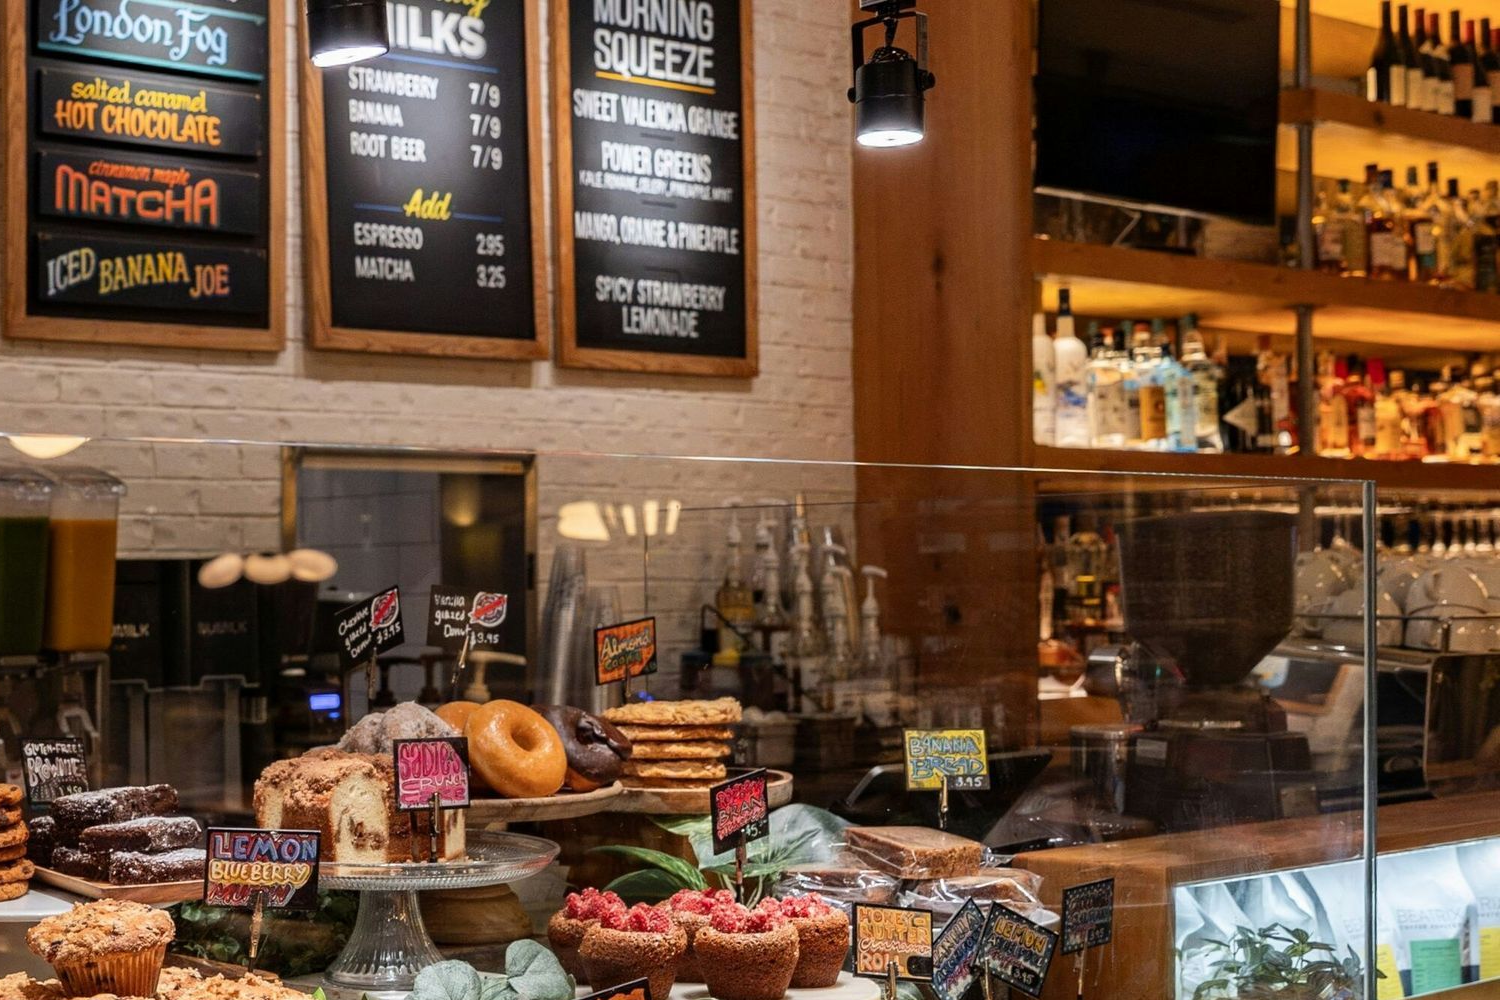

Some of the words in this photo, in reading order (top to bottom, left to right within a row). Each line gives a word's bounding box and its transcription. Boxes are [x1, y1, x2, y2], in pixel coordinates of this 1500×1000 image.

[49, 0, 172, 45] London
[168, 8, 229, 65] Fog
[386, 2, 488, 60] ILKS
[593, 0, 714, 41] MORNING
[593, 28, 715, 86] SQUEEZE
[71, 78, 131, 101] salted
[134, 88, 208, 113] caramel
[348, 66, 440, 100] STRAWBERRY
[55, 99, 98, 130] HOT
[101, 105, 222, 147] CHOCOLATE
[348, 98, 404, 127] BANANA
[573, 88, 619, 122] SWEET
[621, 95, 688, 133] VALENCIA
[687, 106, 739, 140] ORANGE
[350, 131, 388, 158] ROOT
[390, 136, 427, 163] BEER
[601, 141, 653, 175] POWER
[654, 148, 712, 183] GREENS
[55, 164, 219, 226] MATCHA
[403, 188, 453, 221] Add
[353, 222, 424, 250] ESPRESSO
[574, 211, 621, 245] MANGO,
[620, 215, 668, 248] ORANGE
[668, 221, 679, 248] &
[678, 222, 740, 255] PINEAPPLE
[47, 248, 96, 296] ICED
[98, 252, 191, 295] BANANA
[189, 264, 230, 298] JOE
[354, 256, 416, 282] MATCHA
[595, 275, 635, 303] SPICY
[636, 279, 726, 311] STRAWBERRY
[621, 305, 700, 338] LEMONADE
[909, 735, 982, 758] BANANA
[26, 756, 82, 788] BROWNIE
[910, 756, 985, 780] BREAD
[214, 834, 318, 862] LEMON
[210, 859, 308, 881] BLUEBERRY
[859, 922, 930, 945] BUTTER
[994, 915, 1048, 956] LEMON
